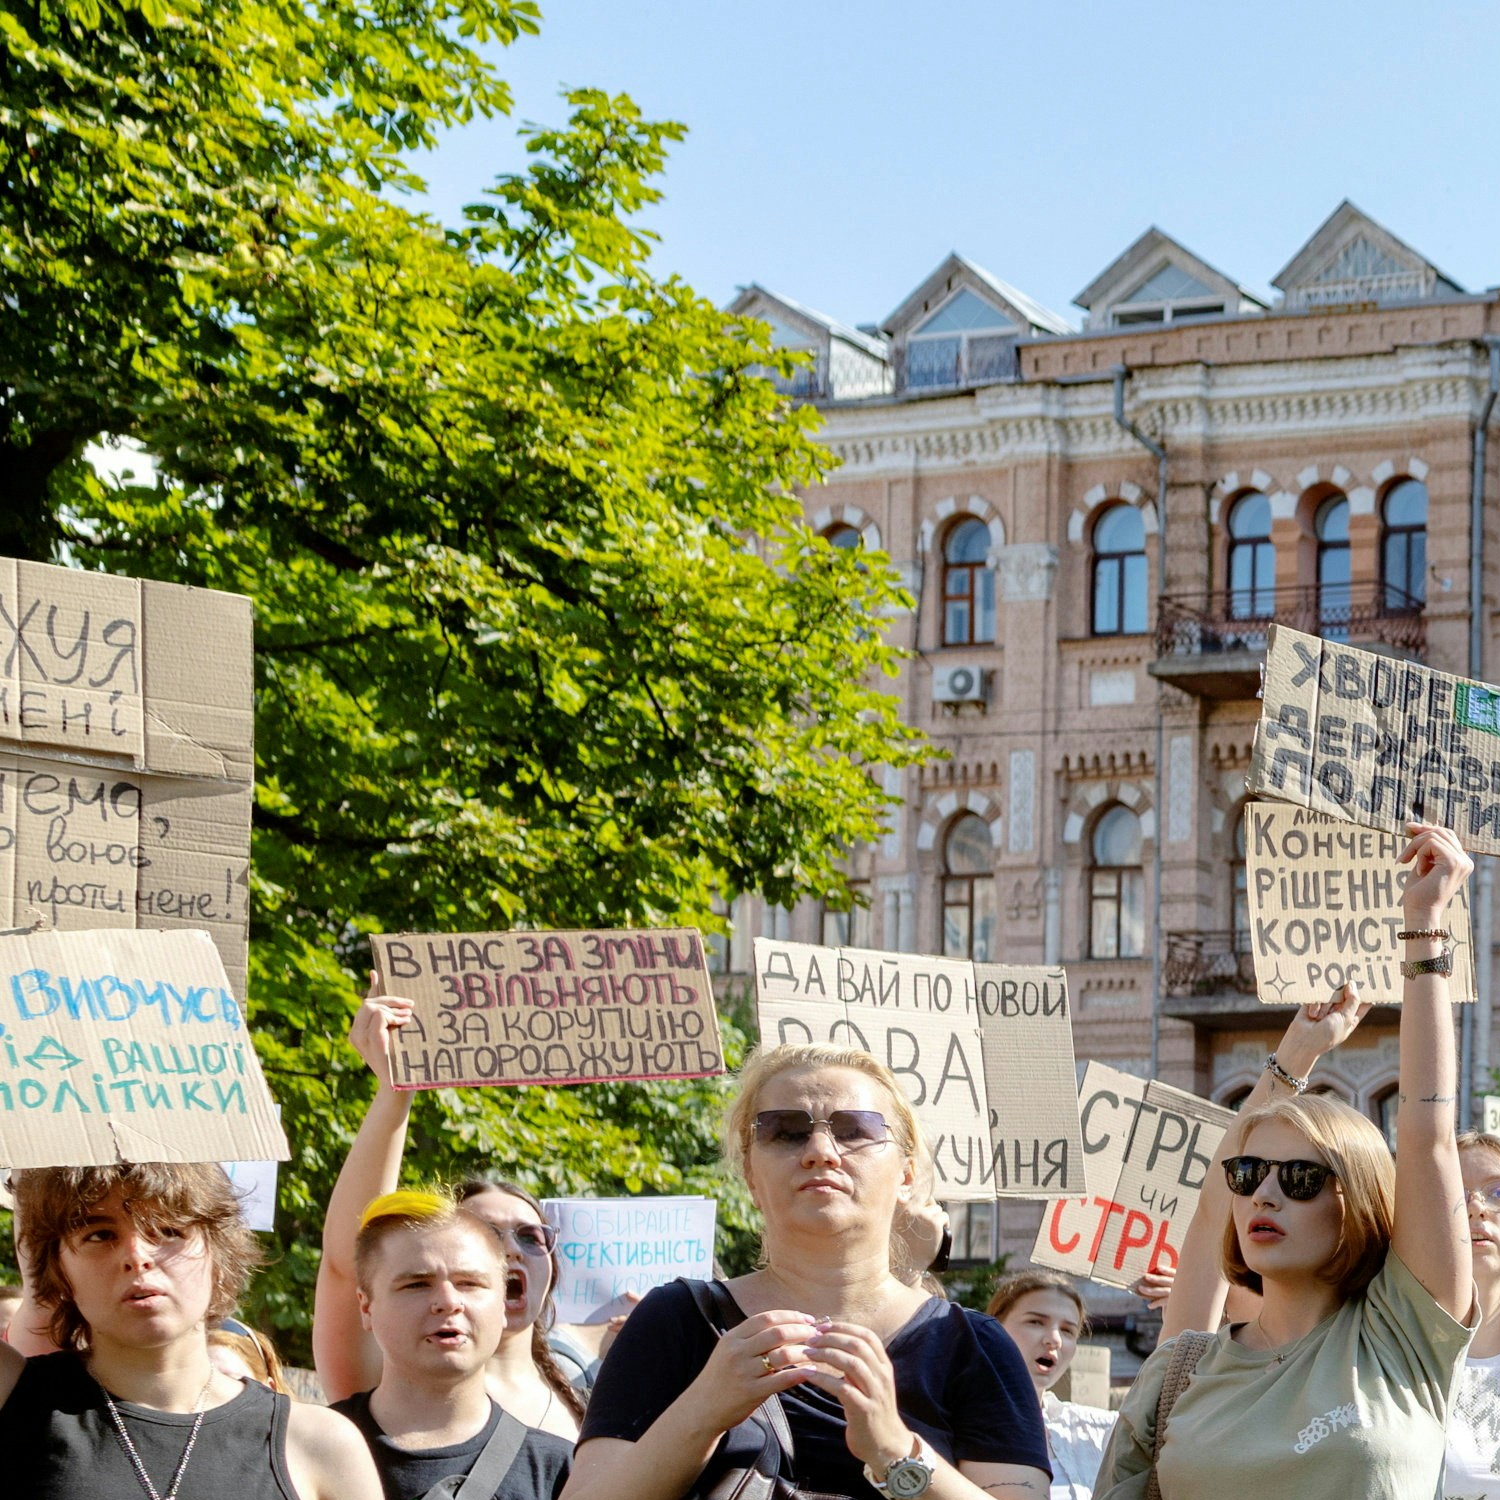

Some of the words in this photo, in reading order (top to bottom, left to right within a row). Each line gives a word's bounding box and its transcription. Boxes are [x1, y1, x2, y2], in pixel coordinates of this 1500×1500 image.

[0, 597, 137, 694] ХУЯ
[1290, 641, 1453, 720] ХВОРЕ
[0, 688, 126, 736] ЕНІ
[1407, 714, 1469, 756] НЕ
[47, 815, 151, 868] воює
[1255, 812, 1406, 860] КОНЧЕН
[28, 875, 126, 926] проти
[386, 941, 422, 978] В
[427, 938, 505, 974] НАС
[516, 935, 576, 973] ЗА
[582, 934, 705, 972] ЗМІНИ
[1256, 916, 1404, 957] КОРИСТ
[439, 972, 699, 1011] ЗВІЛЬНЯЮТЬ
[913, 972, 951, 1012] ПО
[965, 973, 1067, 1019] НОВОЙ
[399, 1010, 426, 1043] А
[437, 1010, 490, 1045] ЗА
[501, 1006, 705, 1042] КОРУПЦІЮ
[4, 1034, 83, 1070] ІД
[102, 1037, 244, 1076] ВАШОЇ
[402, 1040, 721, 1082] НАГОРОДЖУЮТЬ
[572, 1207, 695, 1238] ОБИРАЙТЕ
[1140, 1184, 1178, 1219] ЧИ
[562, 1239, 707, 1269] ФЕКТИВНІСТЬ
